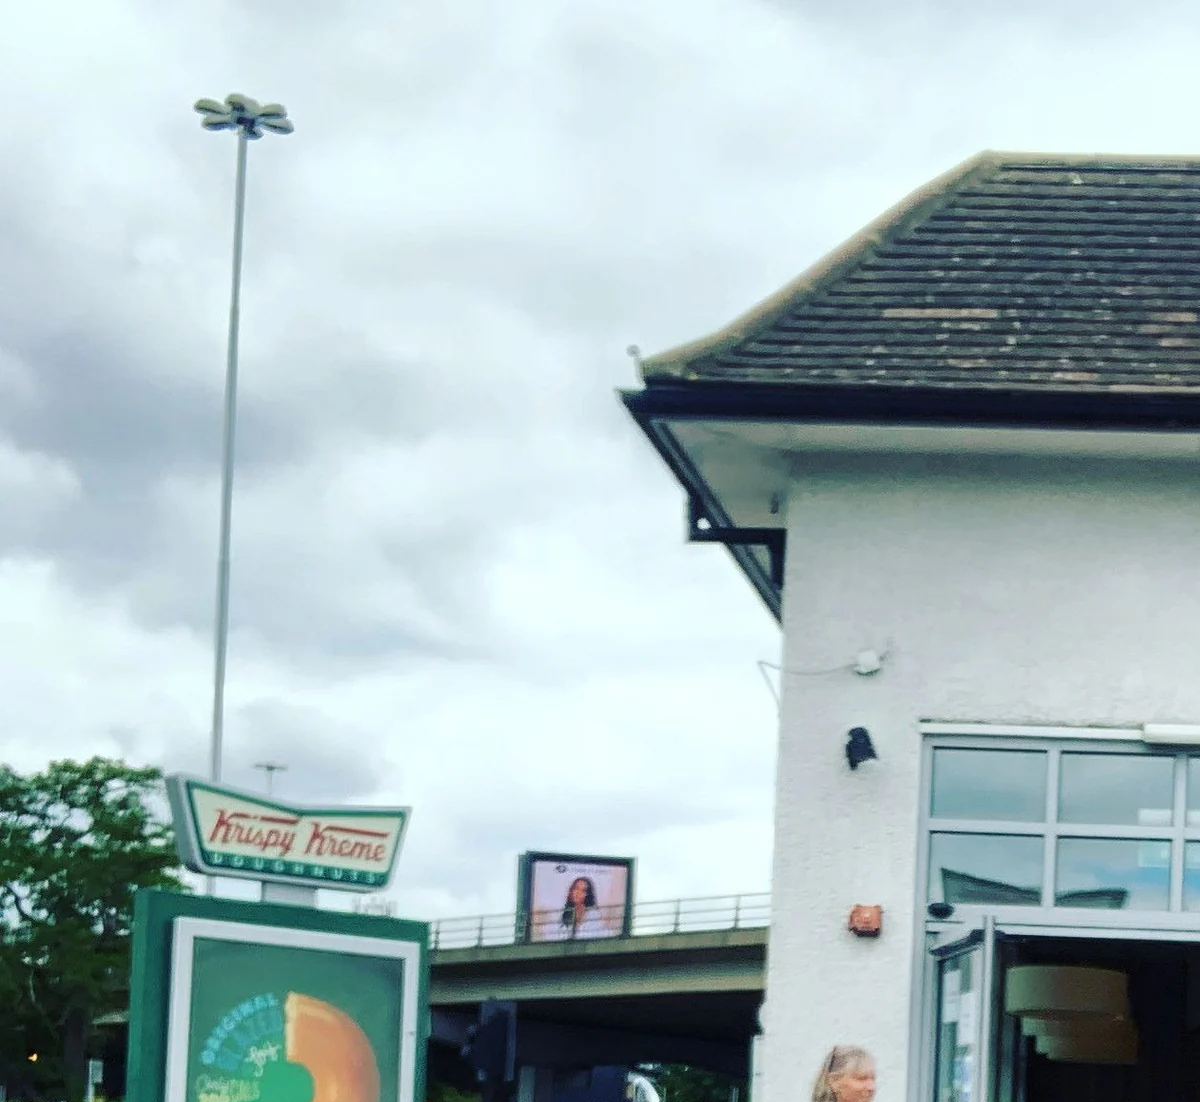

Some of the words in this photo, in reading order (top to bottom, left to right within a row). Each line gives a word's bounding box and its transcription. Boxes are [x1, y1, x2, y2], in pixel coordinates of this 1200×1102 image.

[209, 808, 302, 857] Krispy
[304, 821, 390, 862] Kreme
[212, 852, 376, 884] DOUGHNUTS
